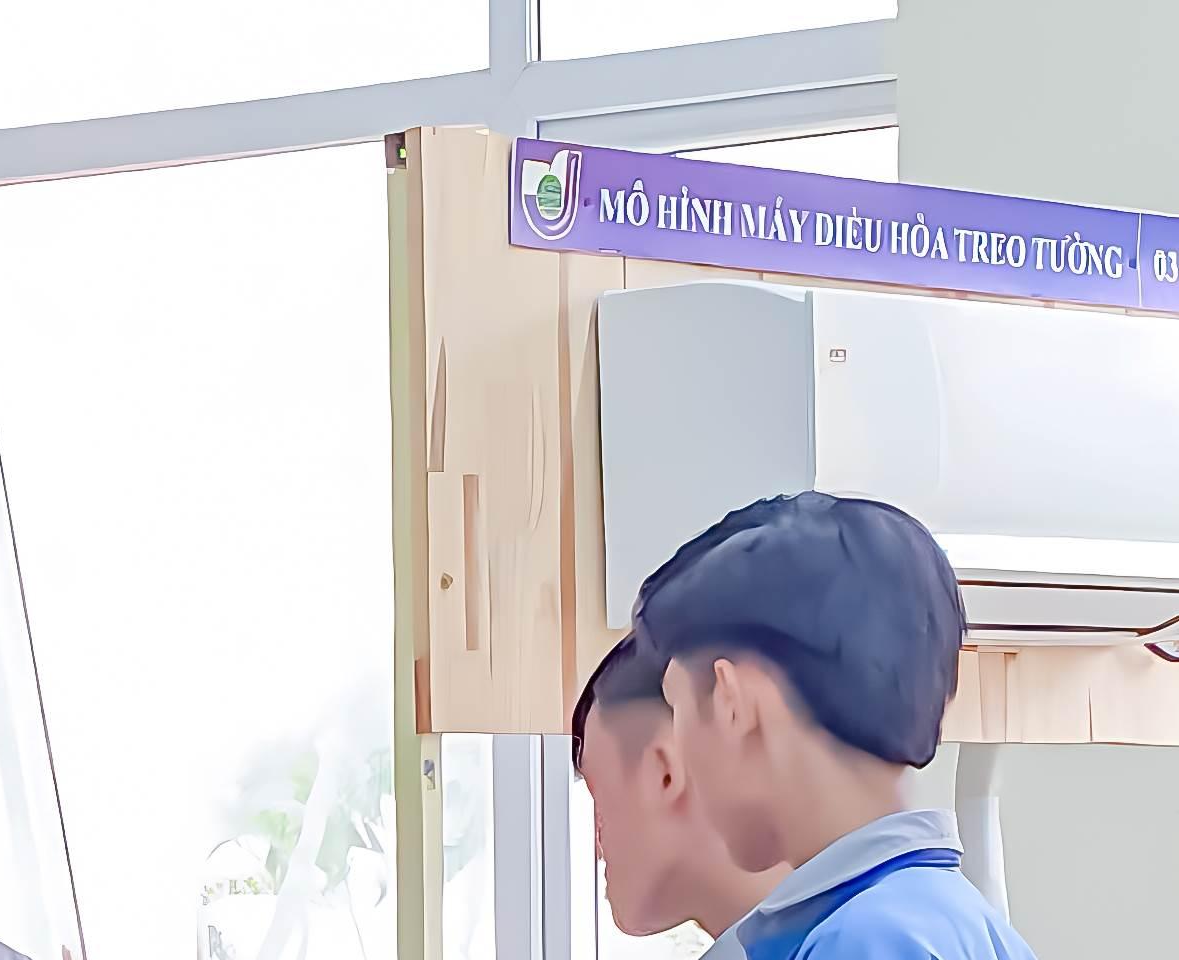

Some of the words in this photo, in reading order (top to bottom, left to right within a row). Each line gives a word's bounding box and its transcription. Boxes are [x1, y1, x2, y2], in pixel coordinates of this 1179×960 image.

[599, 179, 650, 227] MÔ
[741, 195, 810, 243] MÁY
[953, 227, 1027, 268] TREO
